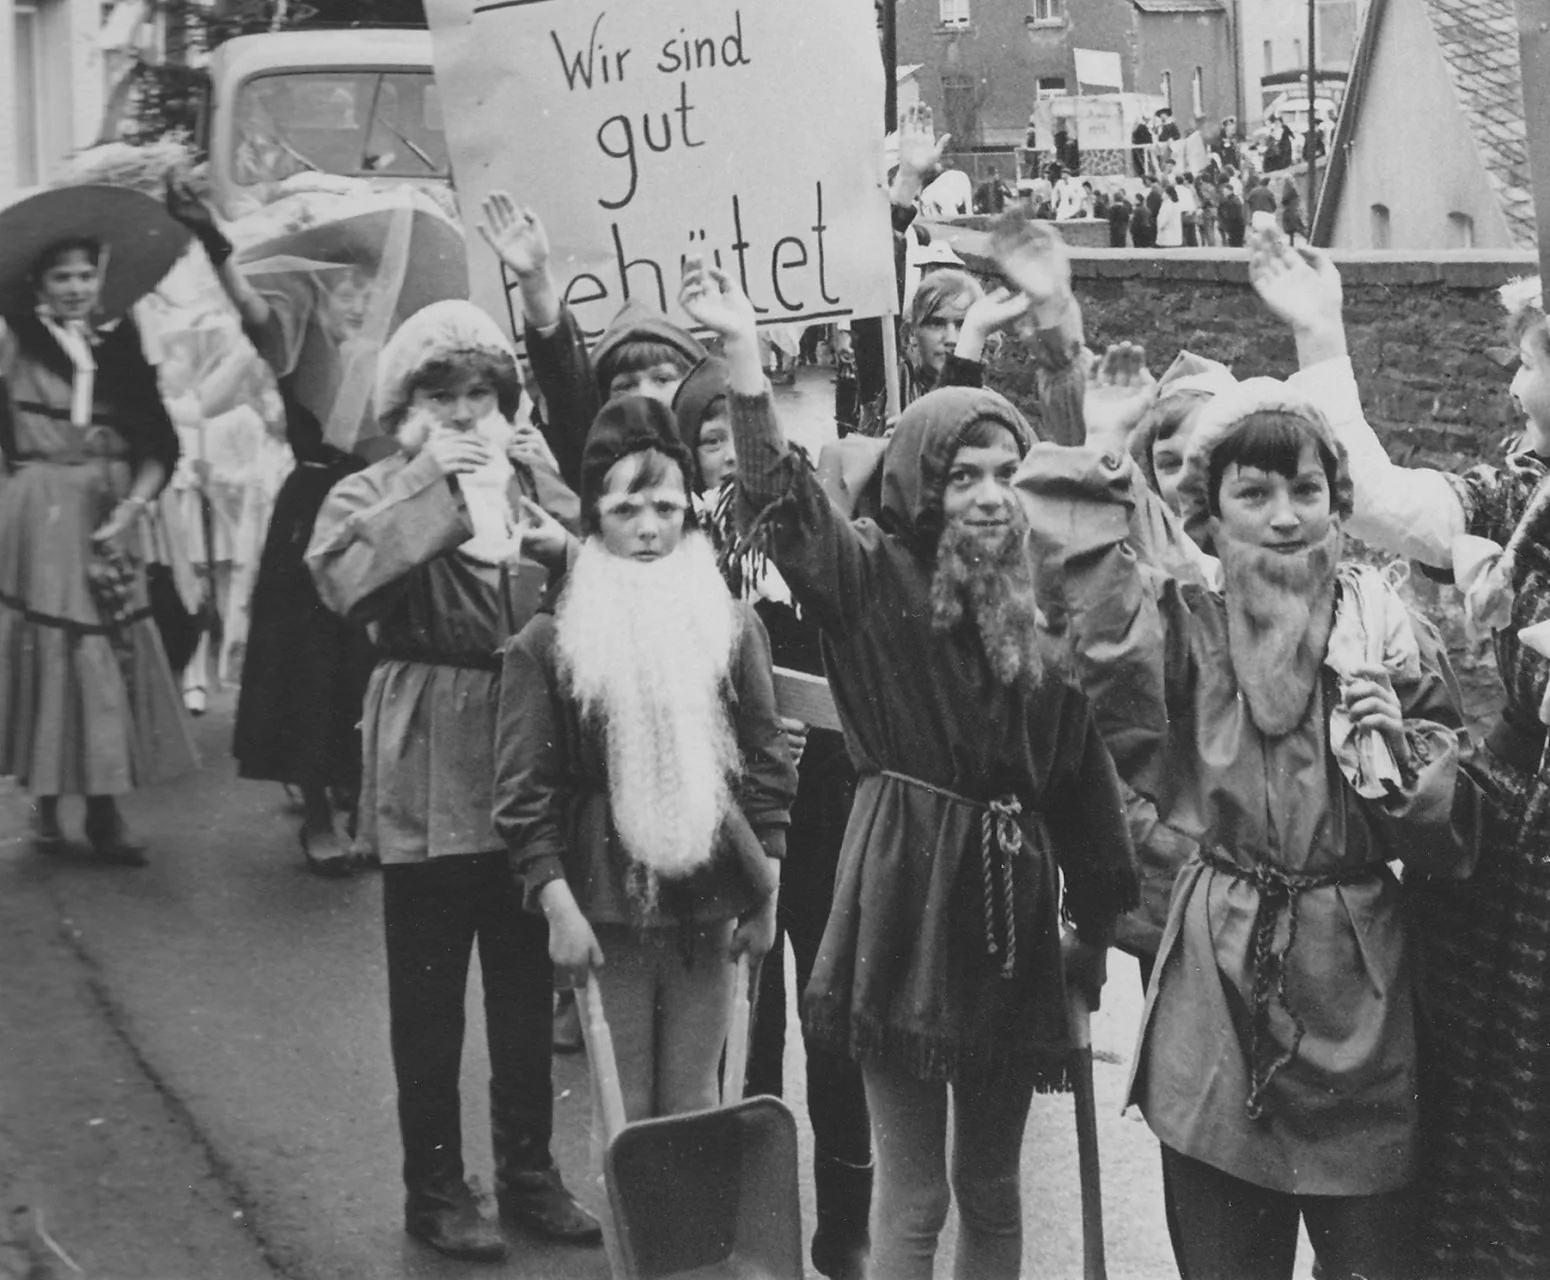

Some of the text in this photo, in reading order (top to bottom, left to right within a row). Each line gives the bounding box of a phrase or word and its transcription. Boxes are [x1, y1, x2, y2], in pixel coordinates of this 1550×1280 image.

[550, 9, 751, 91] Wir sind
[597, 81, 706, 209] gut
